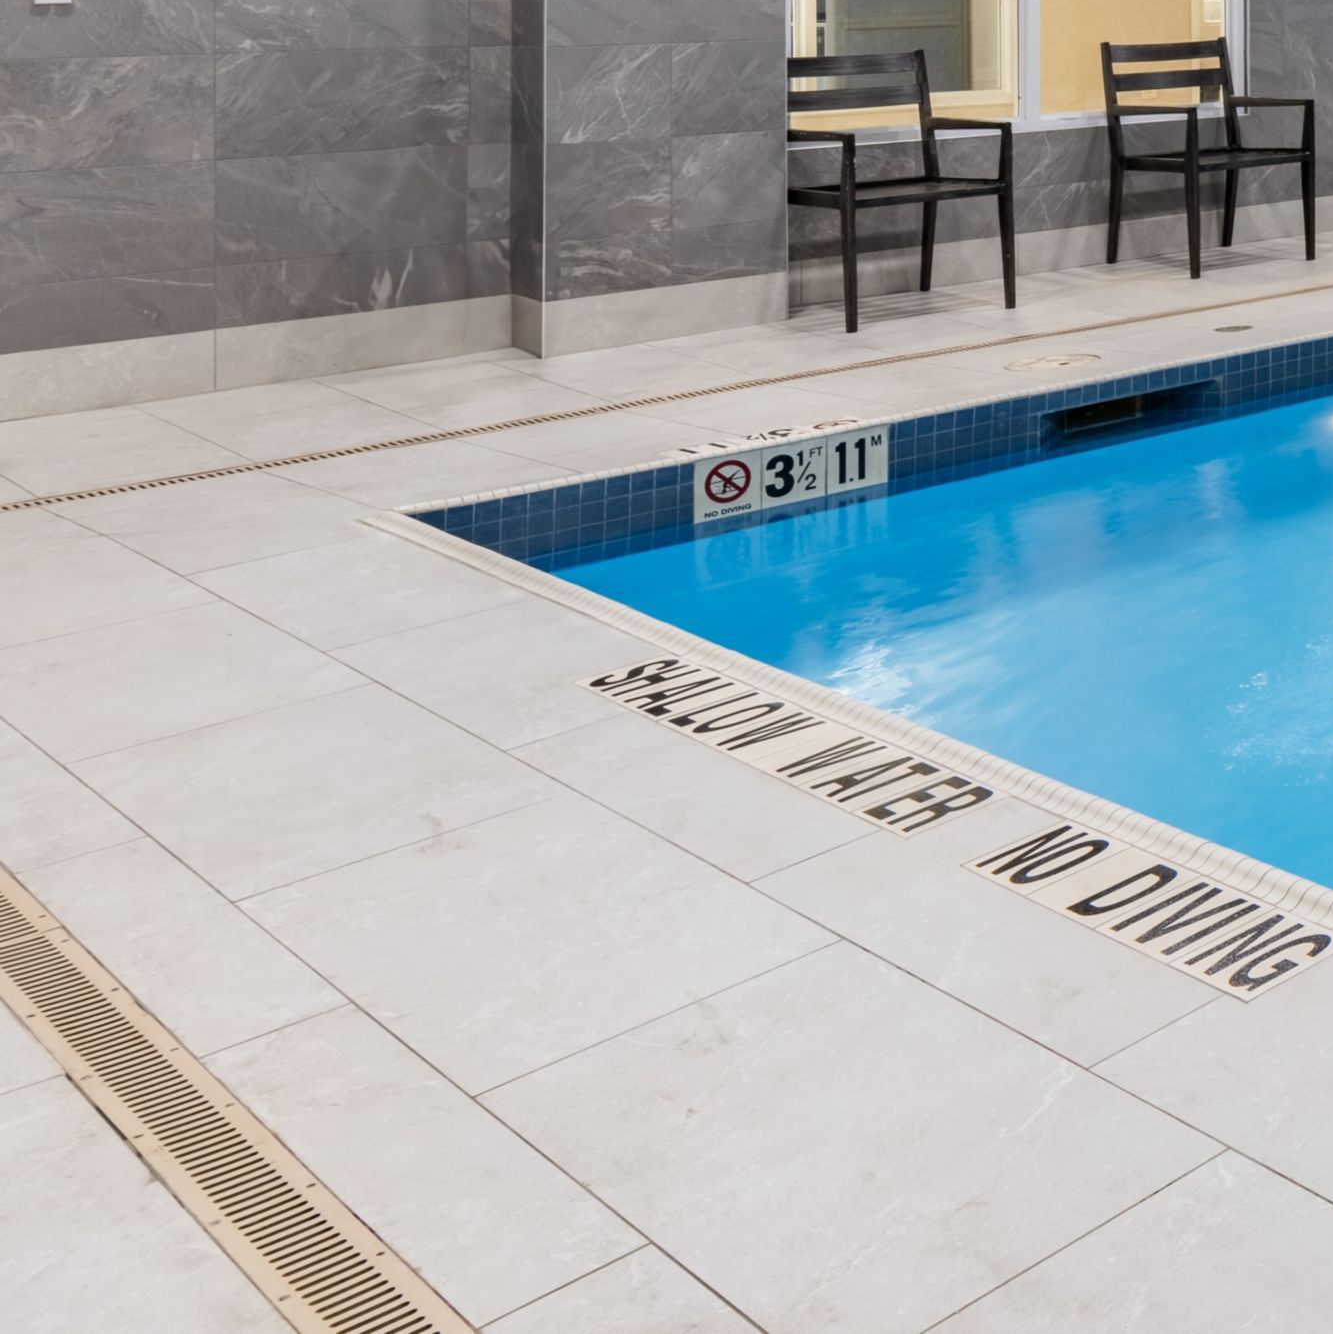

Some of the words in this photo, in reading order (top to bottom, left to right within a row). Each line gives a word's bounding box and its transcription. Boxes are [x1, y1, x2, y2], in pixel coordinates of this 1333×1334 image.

[809, 446, 823, 458] FT
[871, 434, 882, 447] M
[704, 511, 719, 519] NO
[721, 503, 752, 515] DIVING
[589, 658, 826, 752] SHALLOW
[776, 736, 994, 834] WATER
[975, 825, 1111, 885] NO
[1066, 864, 1332, 993] DIVING
